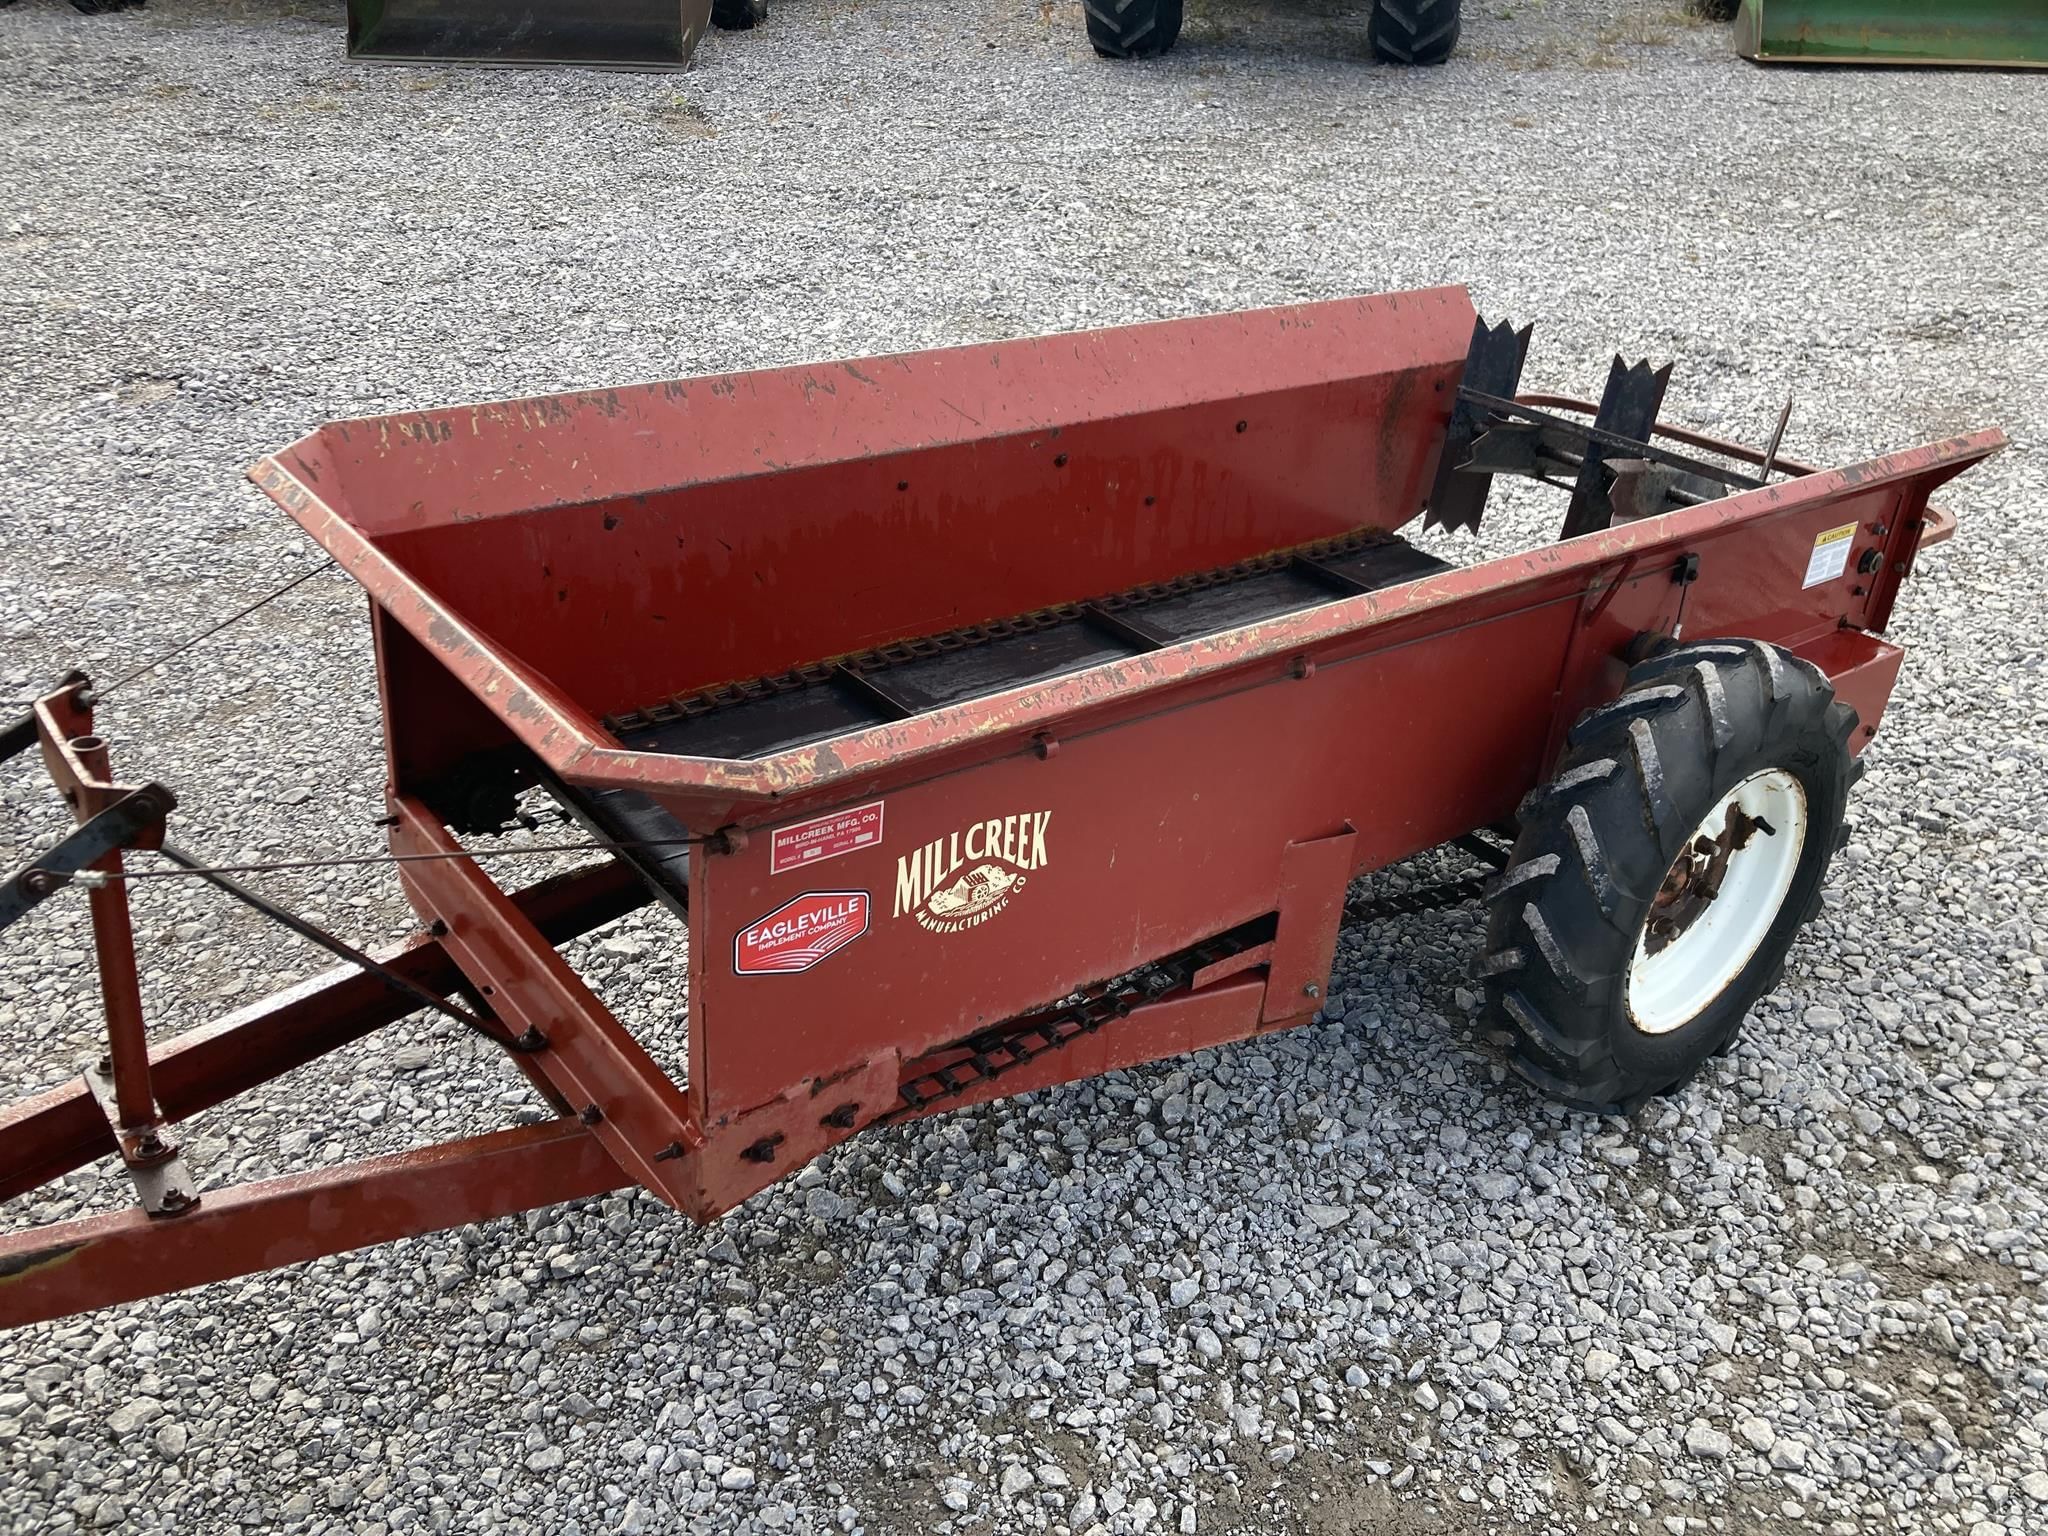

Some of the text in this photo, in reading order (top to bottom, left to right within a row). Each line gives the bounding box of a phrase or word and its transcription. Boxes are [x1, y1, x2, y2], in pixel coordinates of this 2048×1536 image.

[777, 824, 834, 847] MILLCREEK
[837, 818, 860, 831] MFG.
[862, 812, 878, 824] CO.
[892, 810, 1052, 918] MILLCREEK
[746, 896, 860, 947] EAGLEVILLE
[915, 876, 1027, 933] MANUFACTURING CO
[758, 915, 848, 952] IMPLEMENT COMPANY
